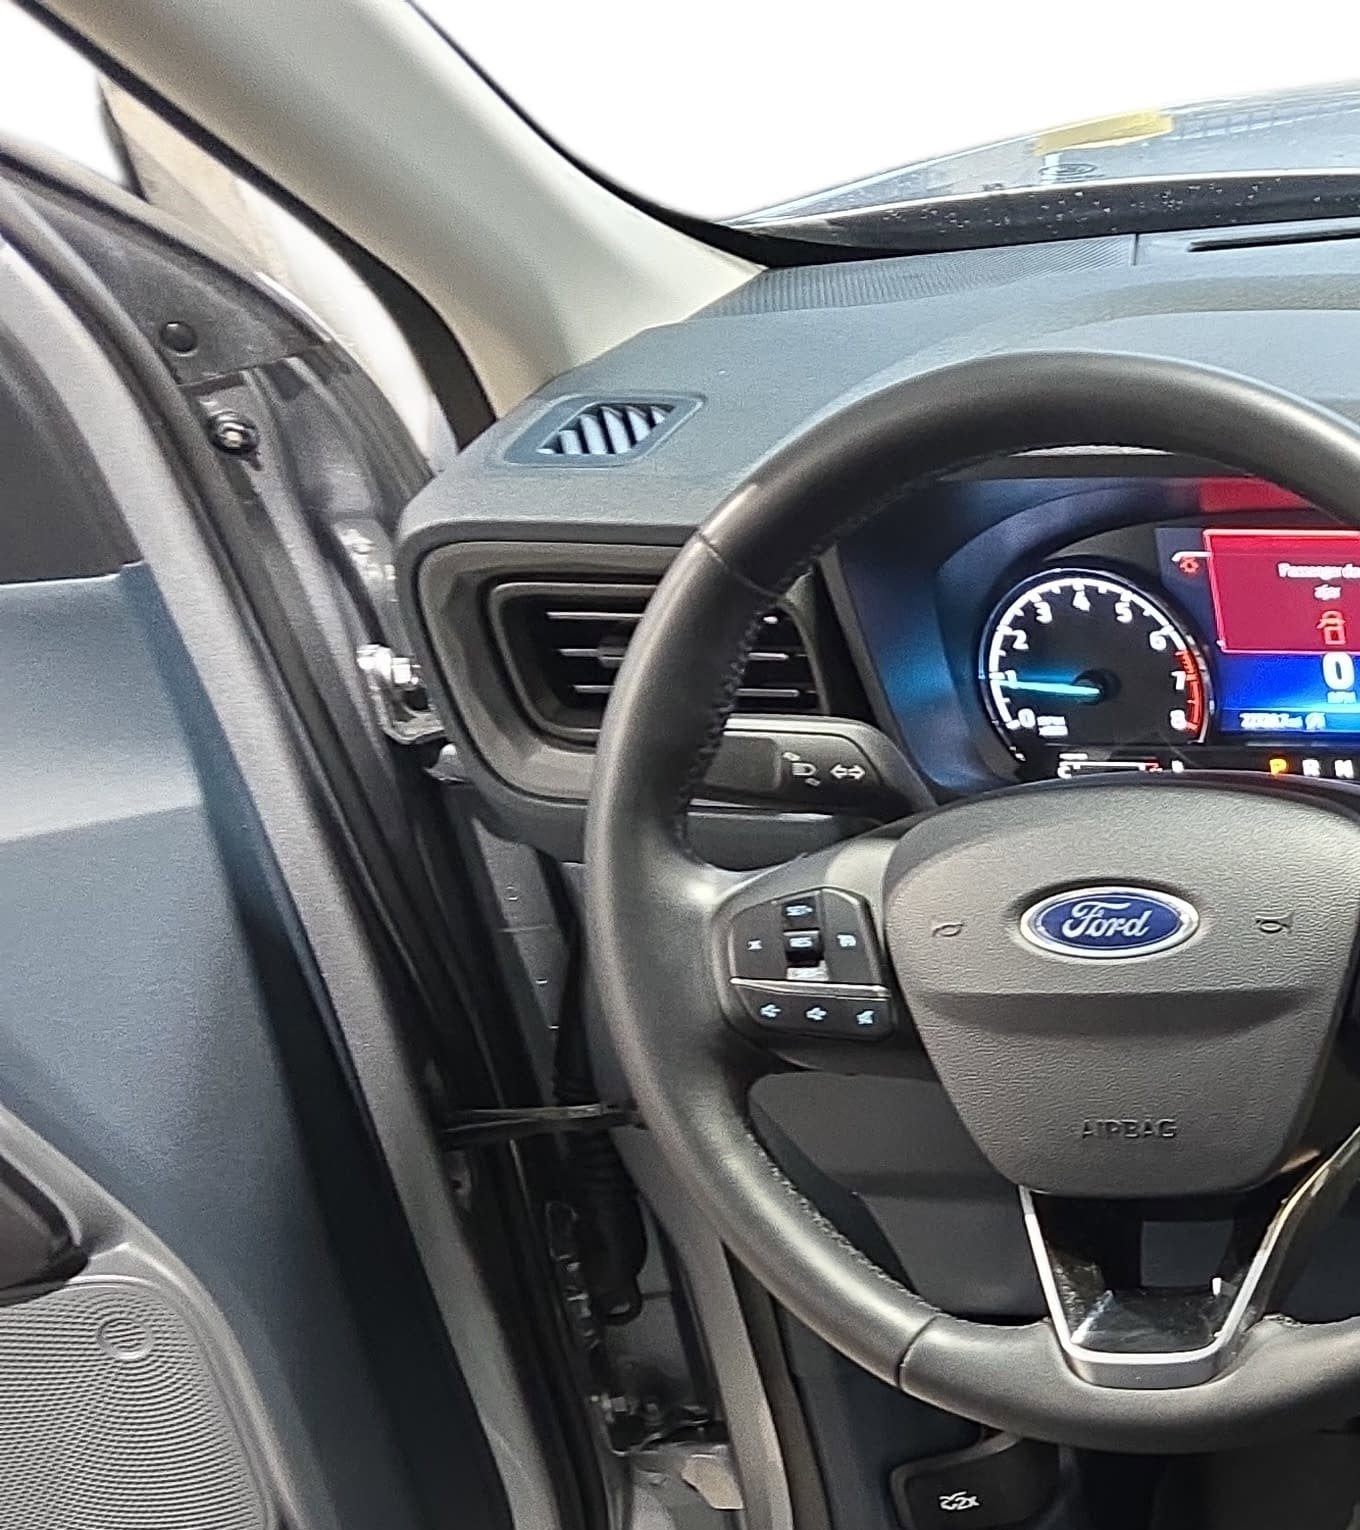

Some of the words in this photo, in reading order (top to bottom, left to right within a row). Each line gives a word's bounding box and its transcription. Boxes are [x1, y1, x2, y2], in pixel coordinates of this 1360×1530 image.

[1073, 590, 1091, 611] 4
[1034, 601, 1052, 623] 3
[1115, 602, 1132, 623] 5
[1010, 630, 1029, 649] 2
[1150, 630, 1167, 650] 6
[1170, 671, 1185, 690] 7
[1322, 652, 1355, 690] 0
[1018, 708, 1035, 729] 0
[1170, 709, 1185, 730] 8
[1270, 758, 1287, 776] P
[1302, 759, 1320, 776] R
[1335, 760, 1354, 779] N
[1062, 901, 1153, 938] Ford
[1081, 1119, 1178, 1139] AIRBAG
